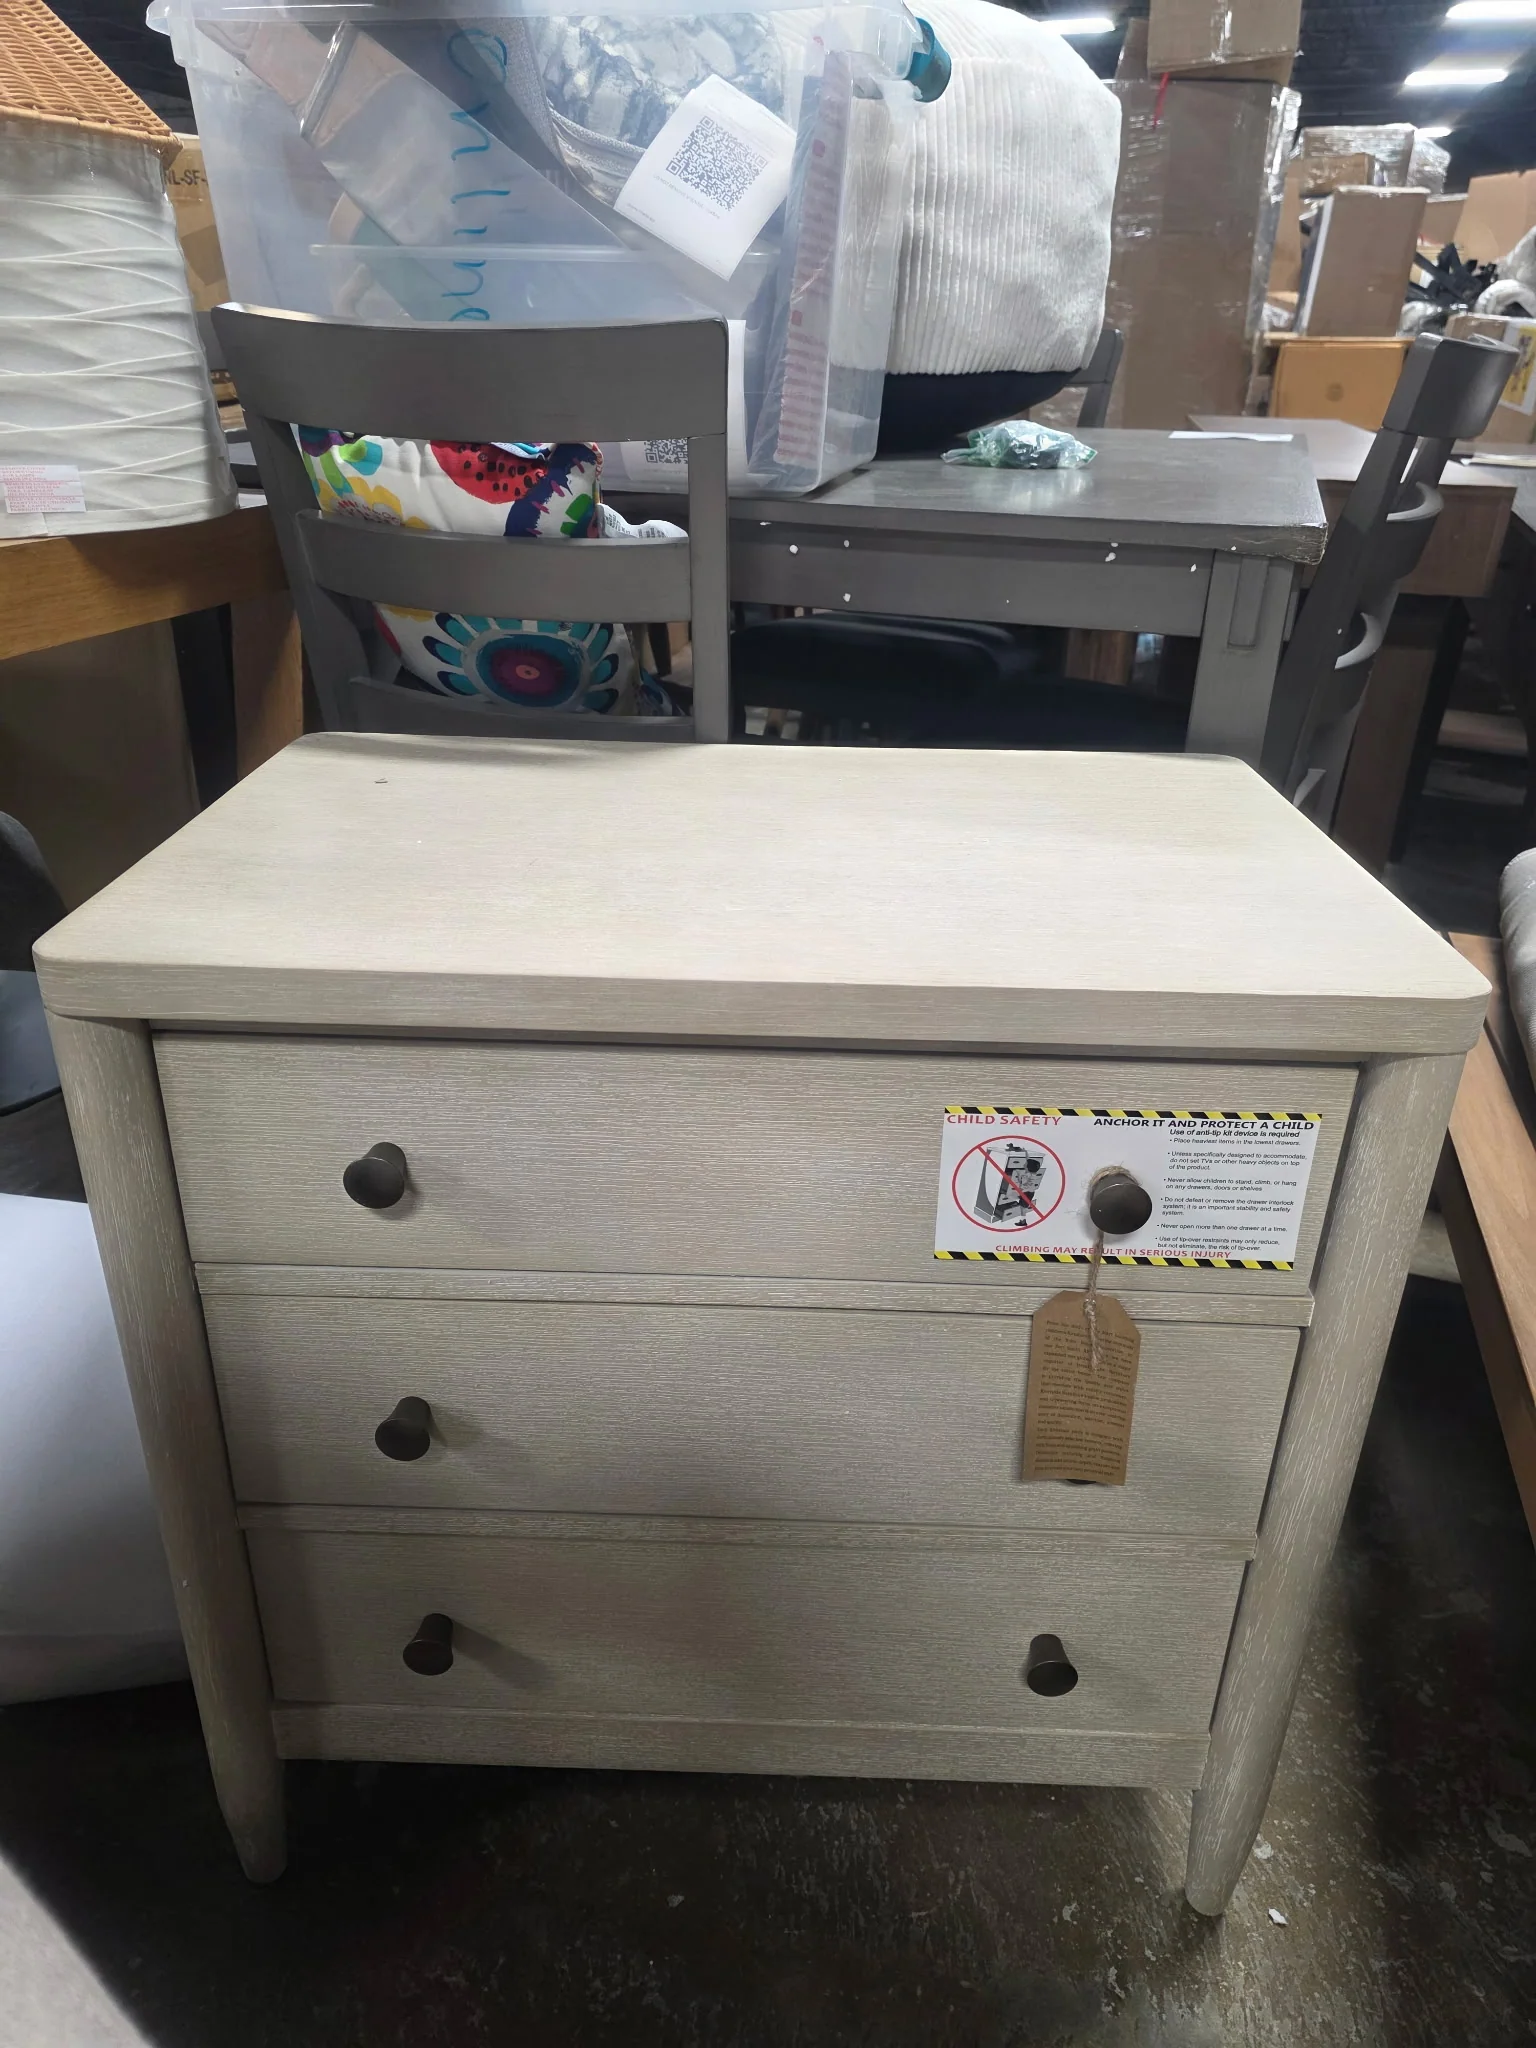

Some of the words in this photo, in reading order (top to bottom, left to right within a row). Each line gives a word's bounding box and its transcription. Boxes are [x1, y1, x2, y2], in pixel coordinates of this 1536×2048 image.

[946, 1114, 995, 1125] CHILD
[999, 1115, 1062, 1126] SAFETY
[1093, 1118, 1150, 1127] ANCHOR
[1152, 1119, 1165, 1127] IT
[1167, 1120, 1197, 1128] AND
[1200, 1120, 1257, 1129] PROTECT
[1259, 1121, 1269, 1130] A
[1272, 1121, 1315, 1130] CHILD
[1169, 1128, 1185, 1136] Use
[1195, 1129, 1222, 1138] anti-tip
[1268, 1131, 1300, 1139] required
[1192, 1151, 1226, 1159] specifically
[995, 1245, 1050, 1253] CLIMBING
[1052, 1246, 1078, 1254] MAY
[1080, 1247, 1123, 1255] REULT
[1124, 1248, 1137, 1256] IN
[1139, 1249, 1188, 1257] SERIOUS
[1191, 1250, 1231, 1259] INJURY
